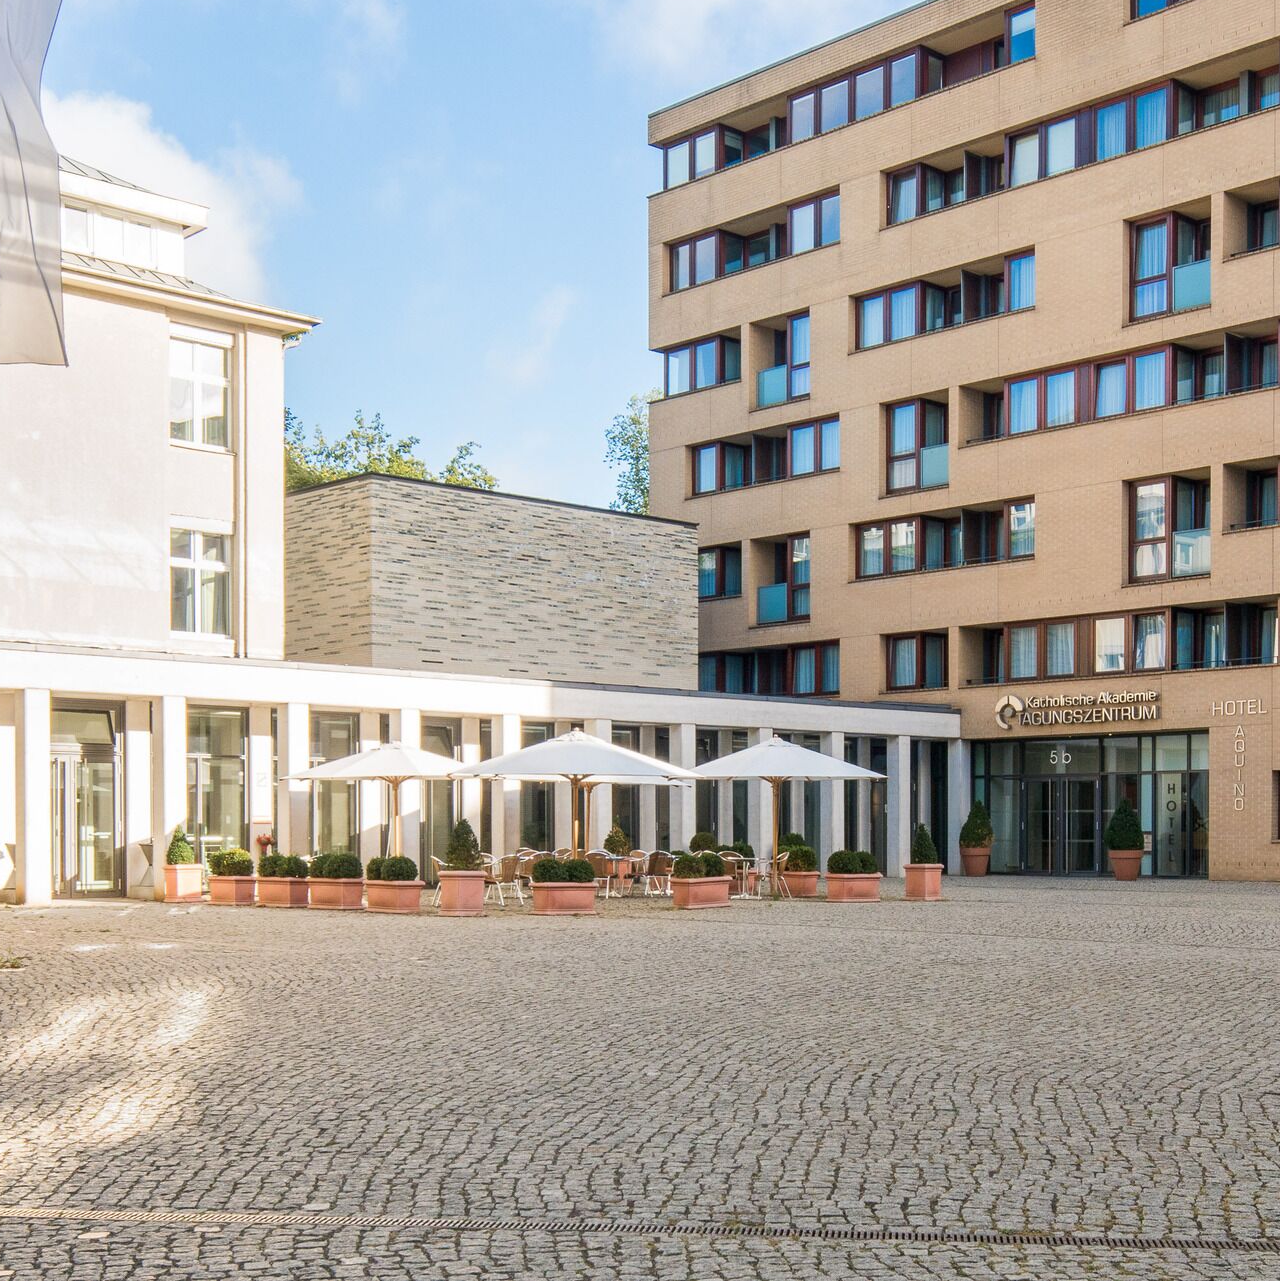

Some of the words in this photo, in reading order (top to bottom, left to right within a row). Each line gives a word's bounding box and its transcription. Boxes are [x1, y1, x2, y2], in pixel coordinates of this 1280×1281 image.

[1025, 694, 1094, 709] Katholische
[1097, 690, 1157, 705] Akademie
[1212, 699, 1267, 716] HOTEL
[1018, 705, 1157, 726] TAGUNGSZENTRUM
[1234, 725, 1245, 811] AQUINO
[1166, 783, 1177, 862] HOTEL
